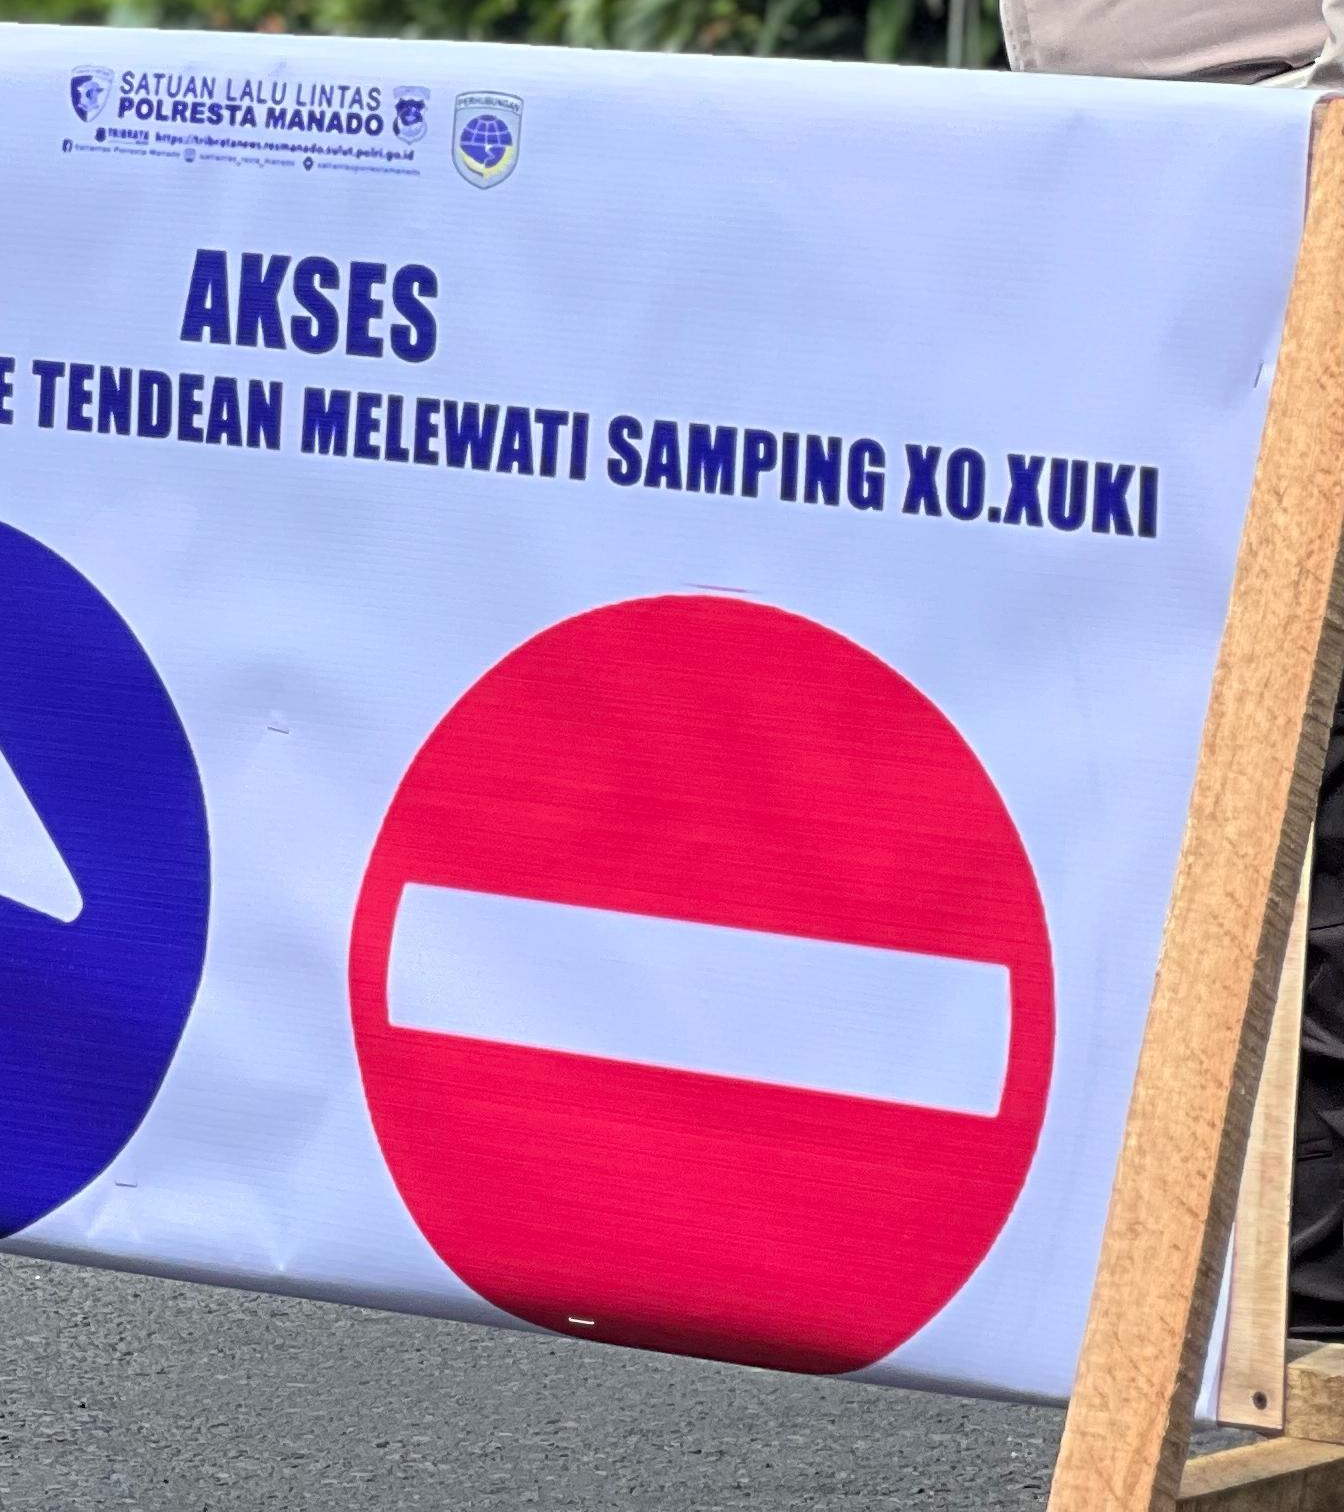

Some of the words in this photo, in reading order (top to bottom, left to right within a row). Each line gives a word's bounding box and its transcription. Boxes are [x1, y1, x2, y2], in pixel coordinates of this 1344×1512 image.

[117, 96, 258, 128] POLRESTA
[265, 106, 385, 137] MANADO
[119, 70, 216, 99] SATUAN
[225, 78, 287, 105] LALU
[296, 83, 382, 111] LINTAS
[180, 248, 438, 363] AKSES
[32, 359, 284, 450] TENDEAN
[300, 387, 589, 481] MELEWATI
[607, 414, 886, 512] SAMPING
[902, 444, 1159, 539] XO.XUKI
